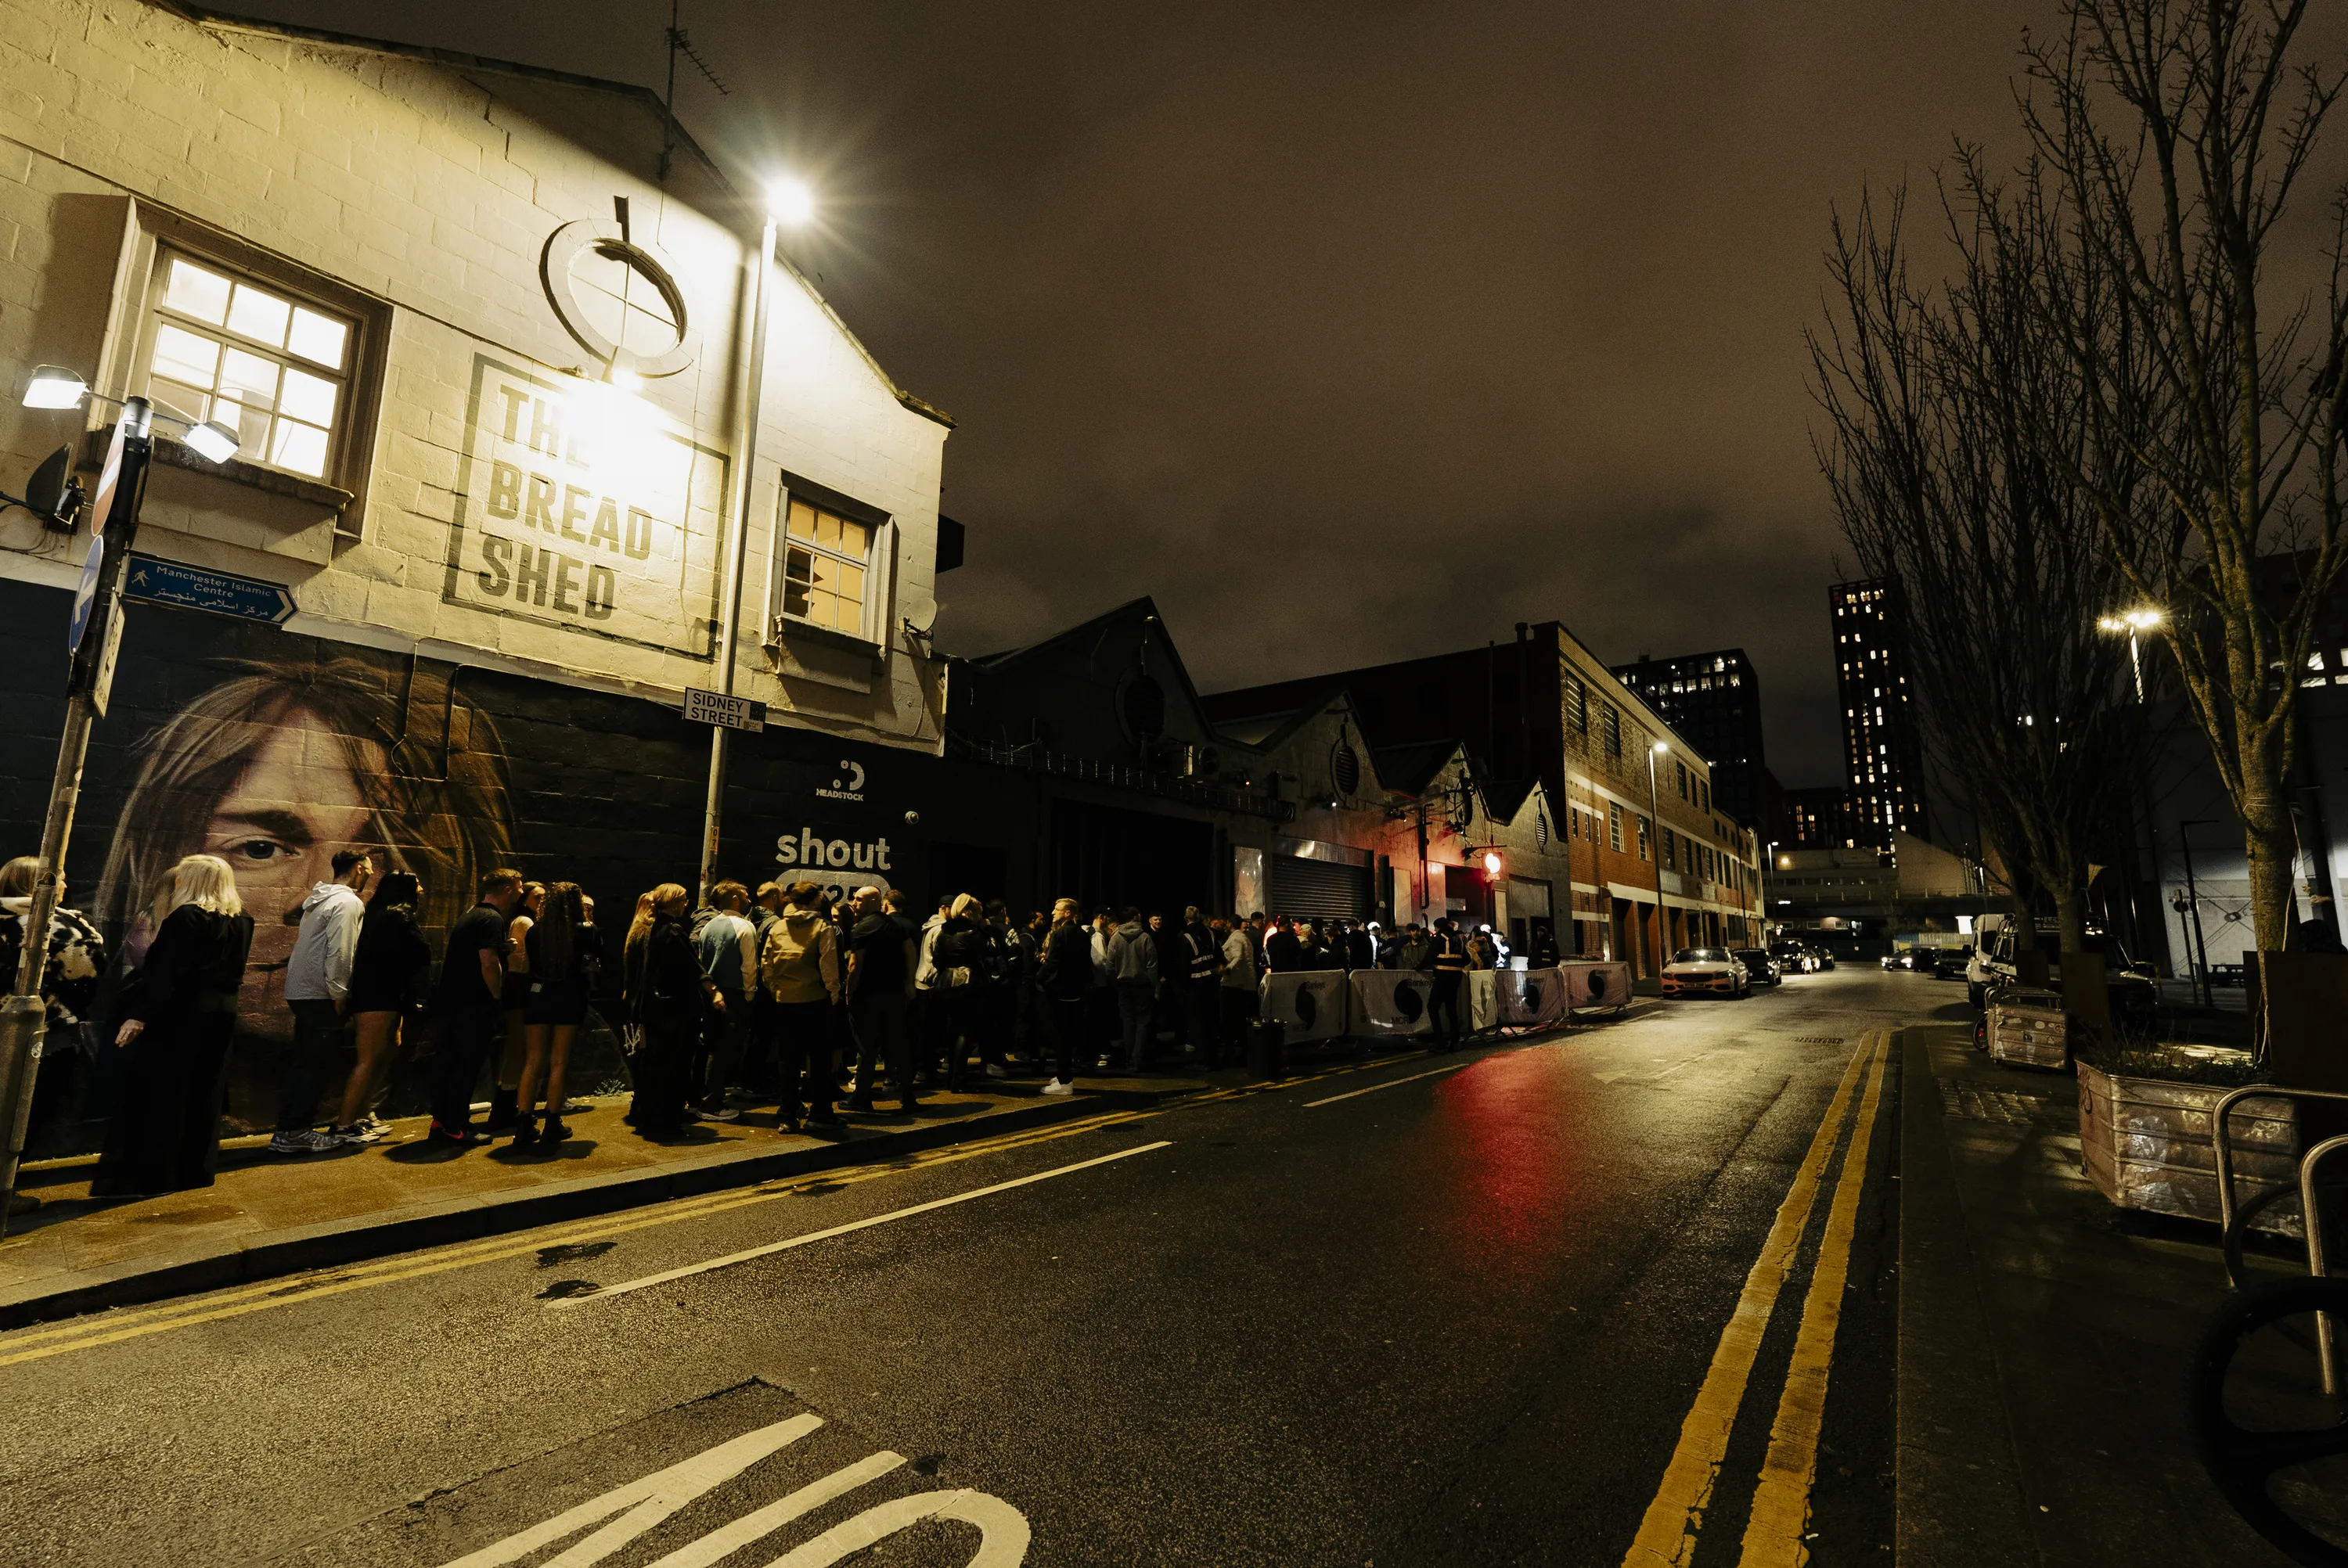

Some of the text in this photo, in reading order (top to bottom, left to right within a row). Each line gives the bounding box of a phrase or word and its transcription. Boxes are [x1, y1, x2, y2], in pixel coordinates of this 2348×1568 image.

[487, 458, 653, 561] BREAD
[157, 566, 272, 597] Manchester Islamic
[477, 534, 616, 621] SHED
[193, 584, 234, 598] Centre
[693, 692, 744, 713] SIDNEY
[691, 707, 743, 727] STREET
[816, 788, 864, 802] HEADSTOCK
[775, 827, 891, 871] shout
